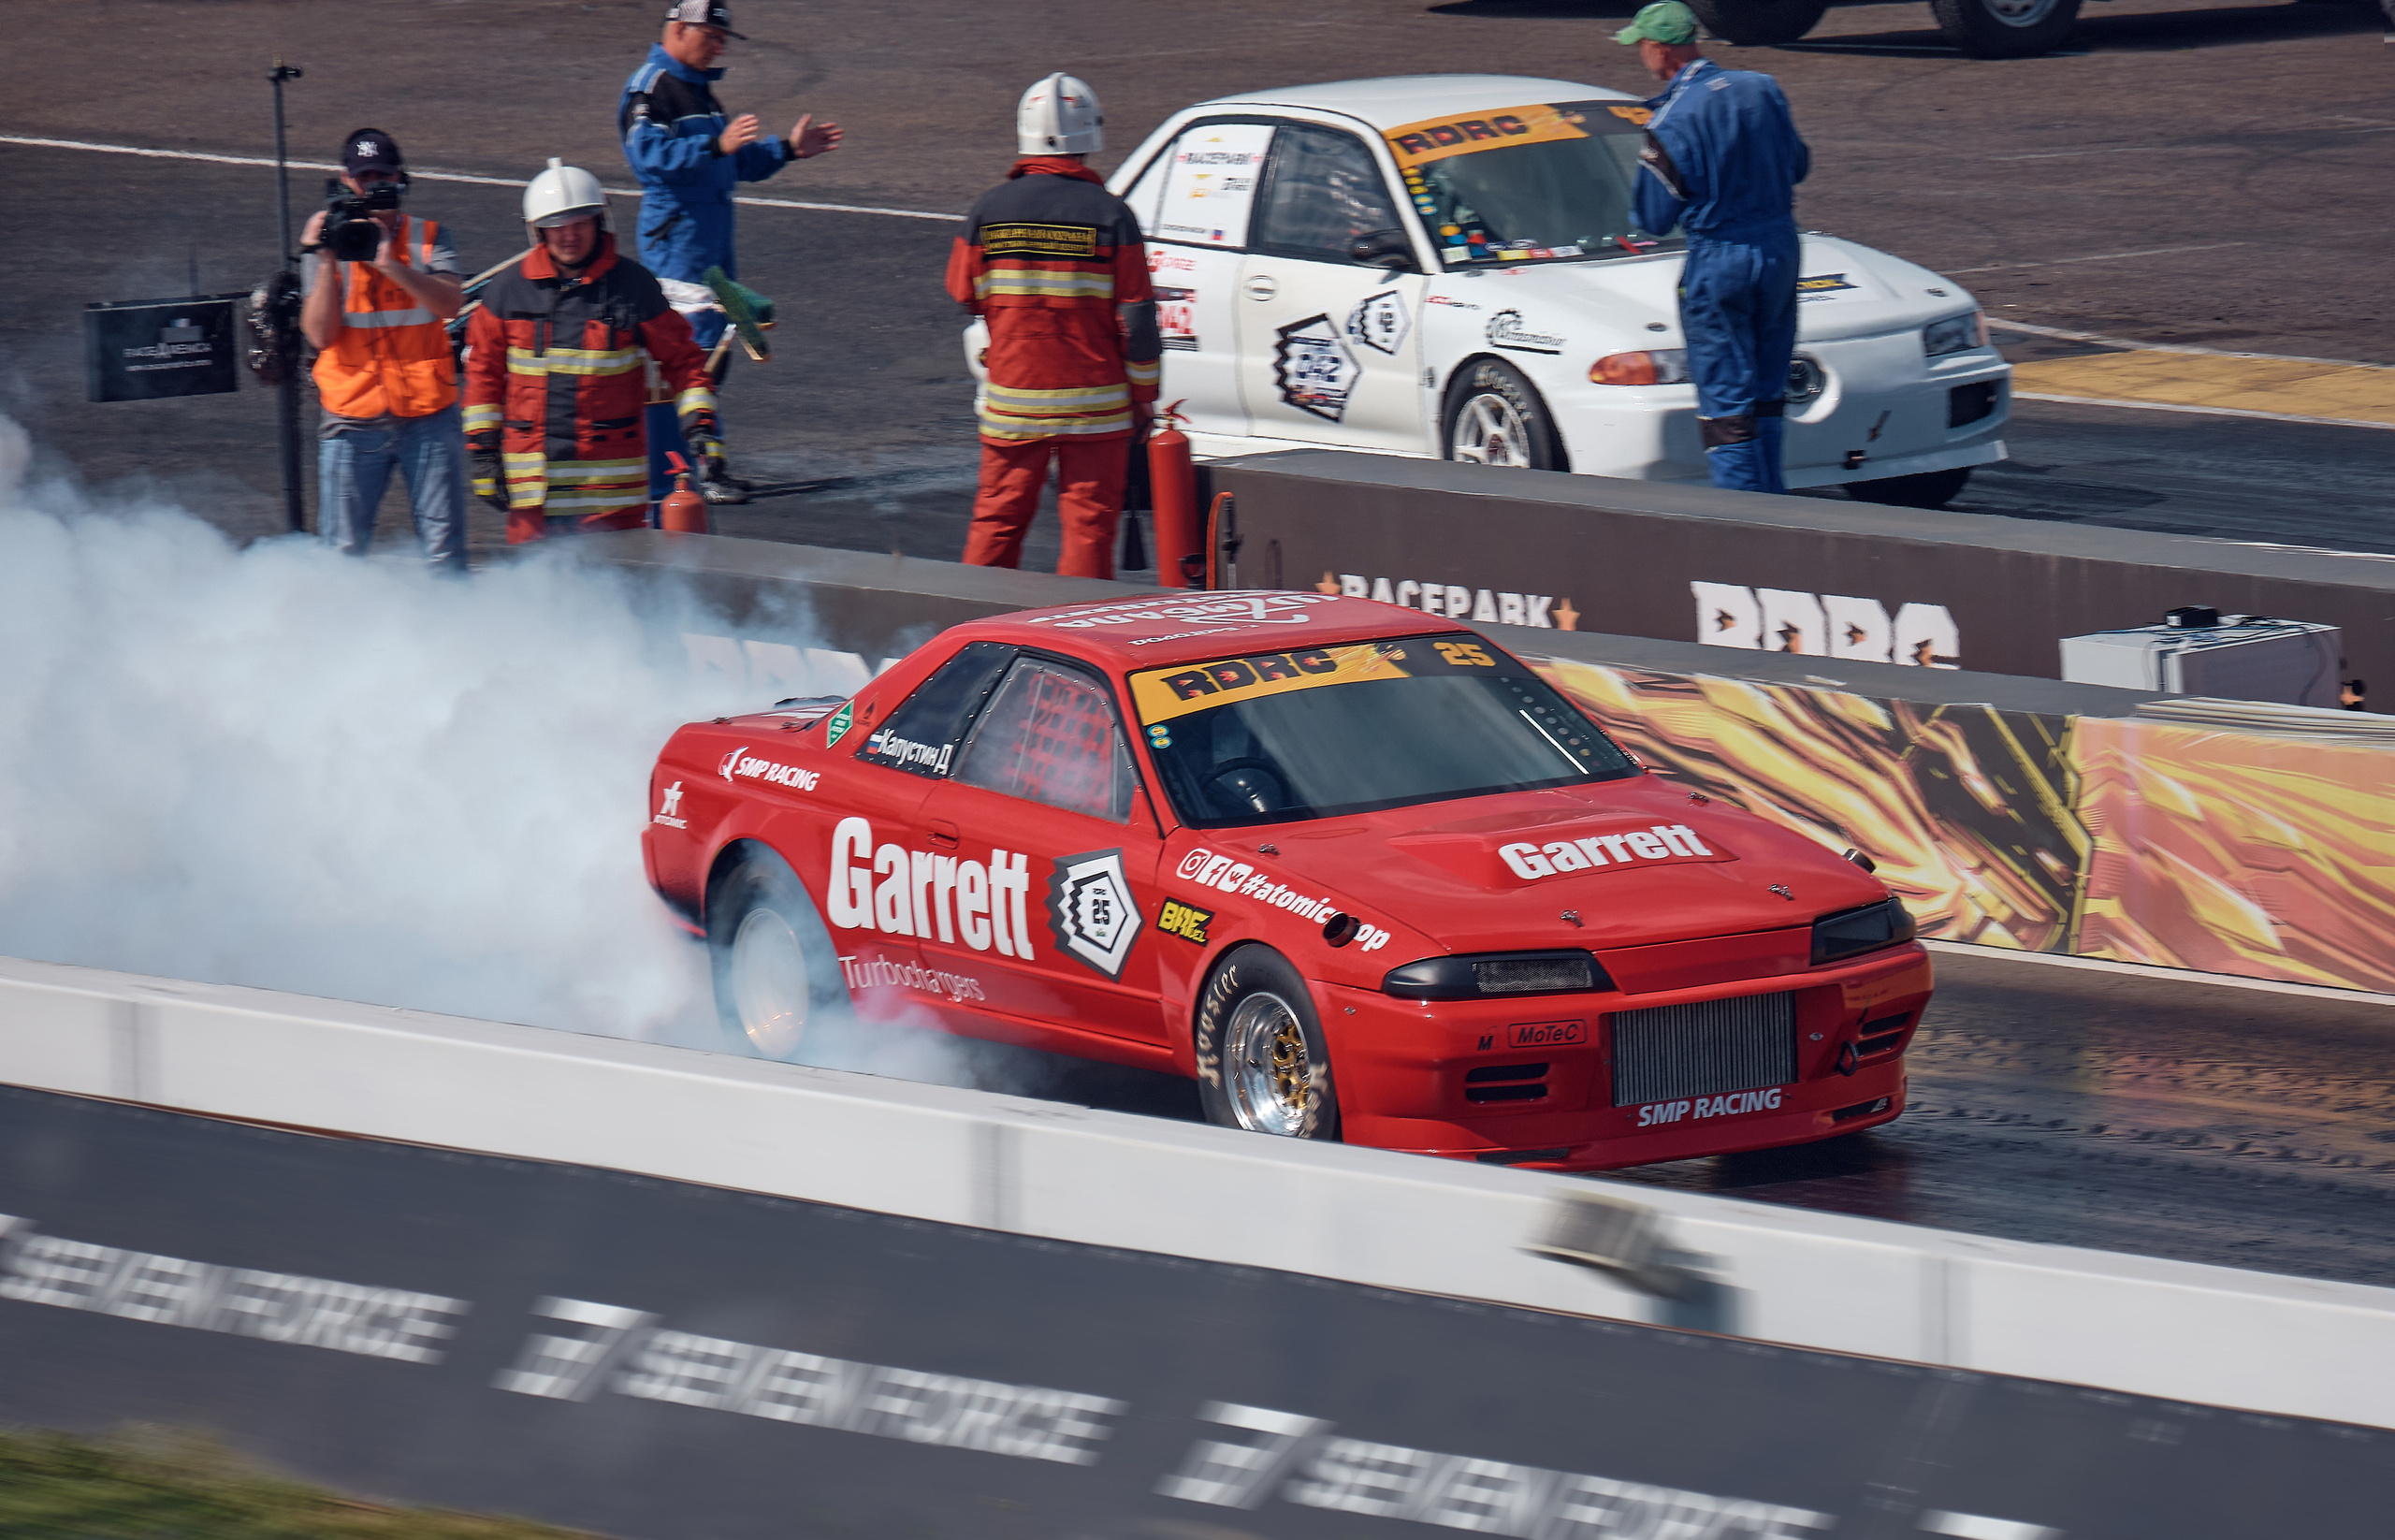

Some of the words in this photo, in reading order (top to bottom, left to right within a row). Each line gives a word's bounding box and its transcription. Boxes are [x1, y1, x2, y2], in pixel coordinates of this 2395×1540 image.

[1393, 114, 1530, 155] RDRC
[1339, 574, 1553, 629] RACEPARK
[1160, 648, 1341, 702] RDRC
[1433, 643, 1497, 668] 25
[877, 728, 940, 766] Капустин
[734, 756, 771, 778] SMP
[763, 763, 821, 792] RACING
[1498, 821, 1714, 880] Garrett
[827, 817, 1036, 961] Garrett
[1239, 872, 1392, 952] #atomicop
[838, 953, 986, 1004] Turbochargers
[1517, 1024, 1579, 1044] MoTeC
[1637, 1104, 1691, 1127] SMP
[1692, 1087, 1782, 1121] RACING
